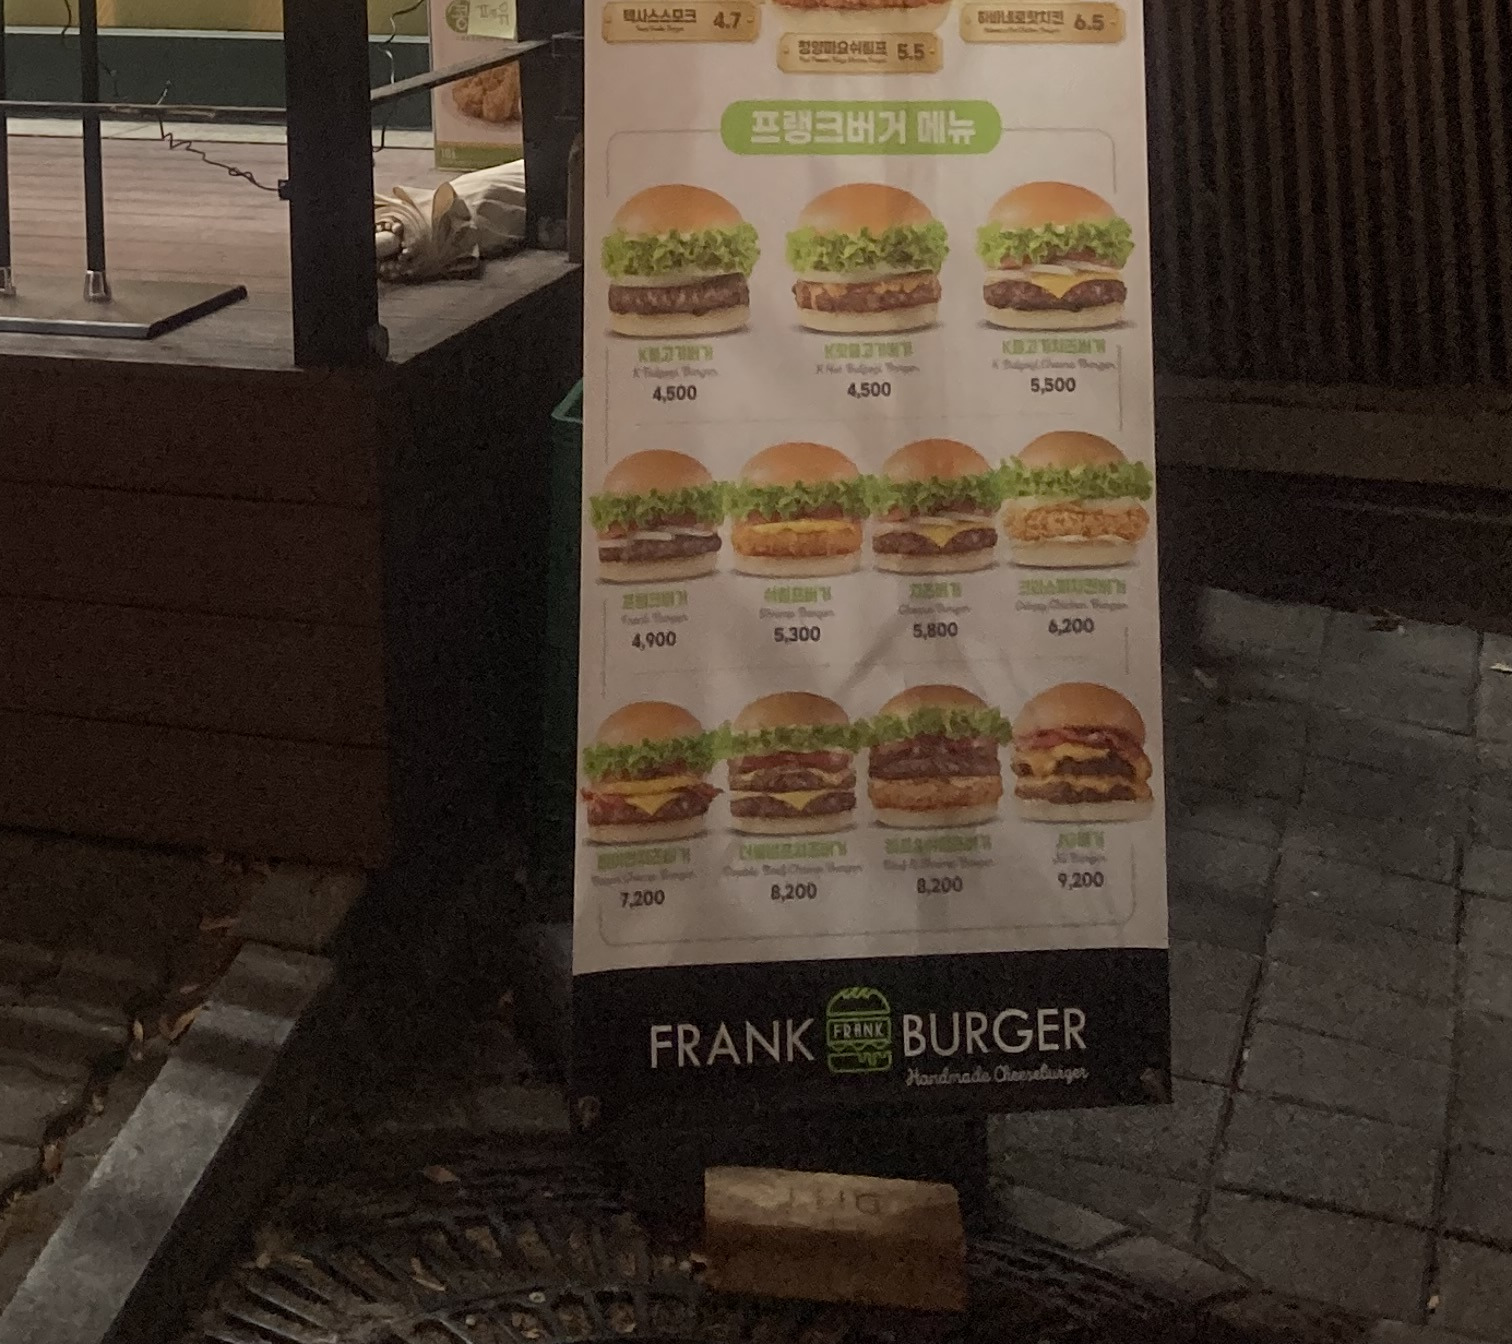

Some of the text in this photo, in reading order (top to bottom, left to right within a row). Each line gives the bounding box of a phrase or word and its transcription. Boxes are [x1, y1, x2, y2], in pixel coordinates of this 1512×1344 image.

[713, 13, 742, 31] 4.7
[1073, 13, 1106, 32] 6.5
[897, 44, 925, 61] 5.5
[751, 109, 977, 146] 프랭크버거 메뉴
[652, 384, 697, 403] 4,500
[847, 381, 891, 399] 4,500
[1030, 376, 1077, 395] 5,500
[774, 625, 821, 644] 5,300
[913, 621, 959, 639] 5,800
[1048, 617, 1095, 636] 6,200
[631, 630, 677, 651] 4,900
[916, 876, 963, 896] 8,200
[1057, 871, 1105, 890] 9,200
[619, 888, 666, 909] 7,200
[770, 882, 818, 902] 8,200
[650, 1008, 1086, 1069] FRANK FRANK BURGER
[906, 1066, 990, 1087] Handmade
